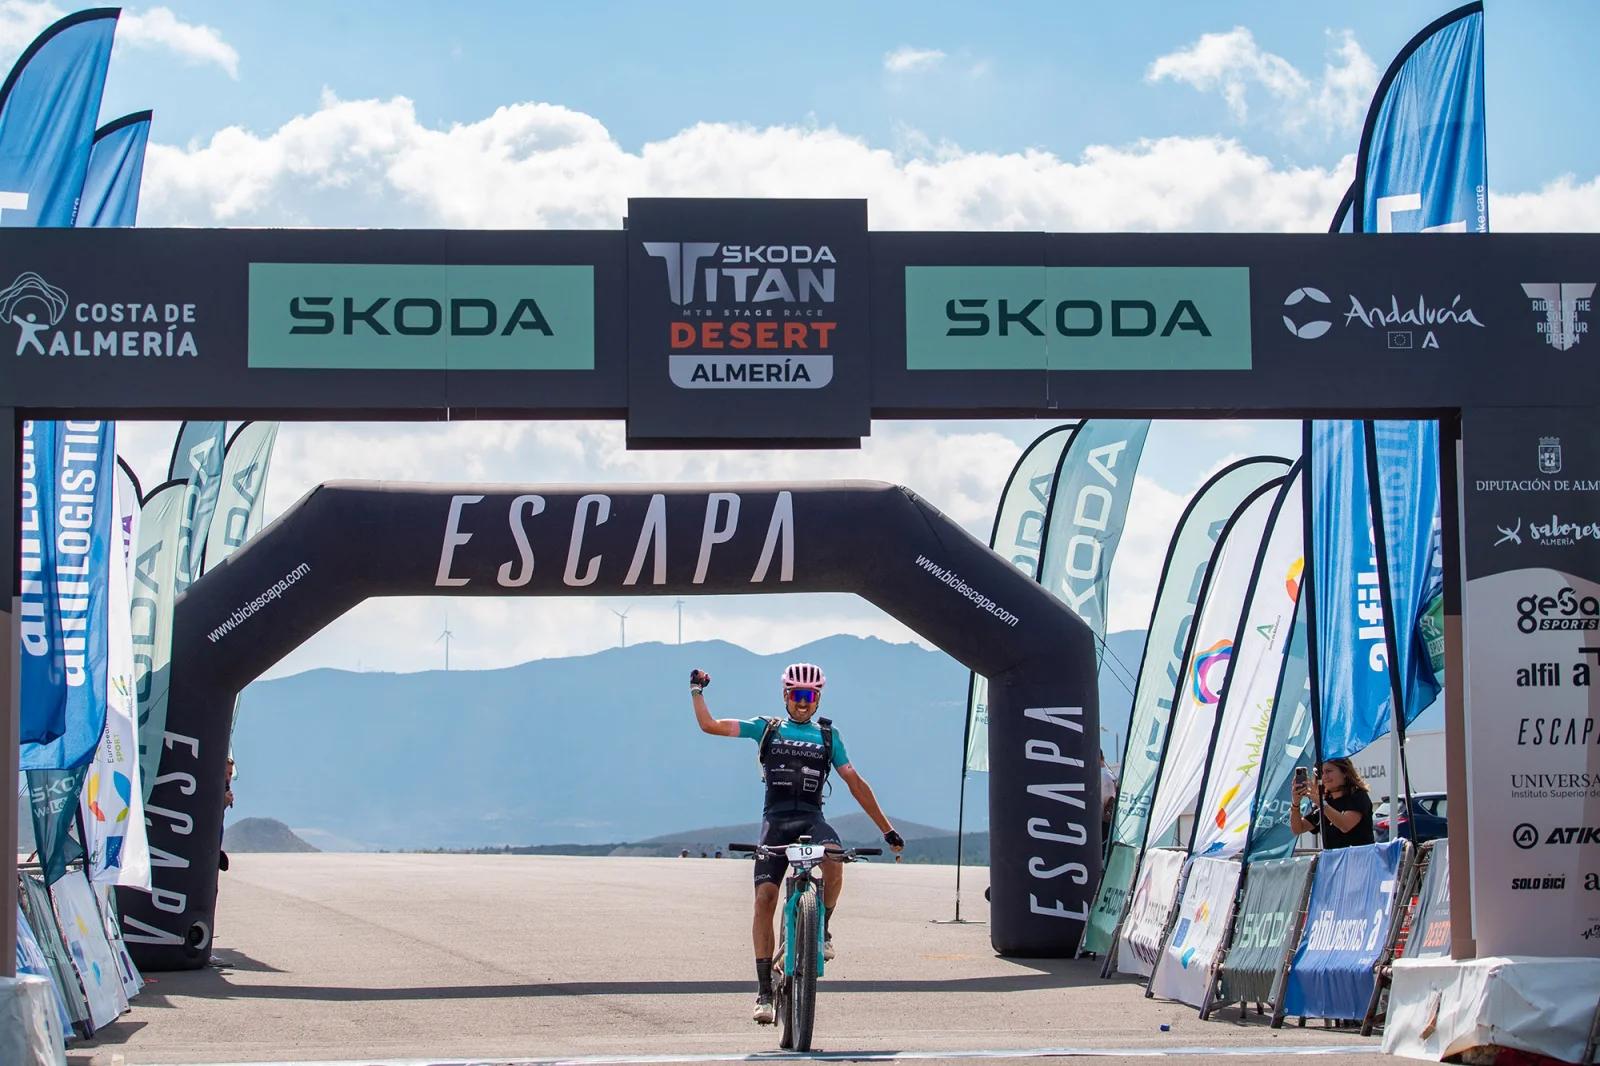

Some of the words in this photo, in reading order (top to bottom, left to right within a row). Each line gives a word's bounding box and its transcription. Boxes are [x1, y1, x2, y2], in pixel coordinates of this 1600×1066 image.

[1475, 185, 1486, 212] care
[75, 302, 160, 325] COSTA
[166, 302, 196, 325] DE
[682, 308, 713, 320] MTB
[723, 308, 774, 320] STAGE
[783, 308, 824, 320] RACE
[1573, 300, 1591, 311] THE
[49, 323, 198, 357] ALMERÍA
[670, 322, 838, 349] DESERT
[690, 357, 812, 383] ALMERÍA
[1476, 478, 1551, 491] DIPUTACIÓN
[1554, 481, 1570, 491] DE
[435, 490, 795, 588] ESCAPA
[207, 561, 310, 643] www.biciescapa.com
[915, 553, 1020, 628] www.biciescapa.com
[1541, 620, 1598, 630] SPORTS
[1516, 662, 1561, 687] alfil
[772, 738, 825, 750] SCOTT
[1517, 718, 1600, 746] ESCAP
[112, 733, 124, 763] SPORT
[791, 749, 824, 760] BANDIDA
[1511, 789, 1548, 798] Instituto
[1550, 789, 1586, 800] Superior
[1024, 707, 1089, 922] ESCAPA
[799, 847, 813, 856] 10
[1511, 878, 1541, 890] SOLO
